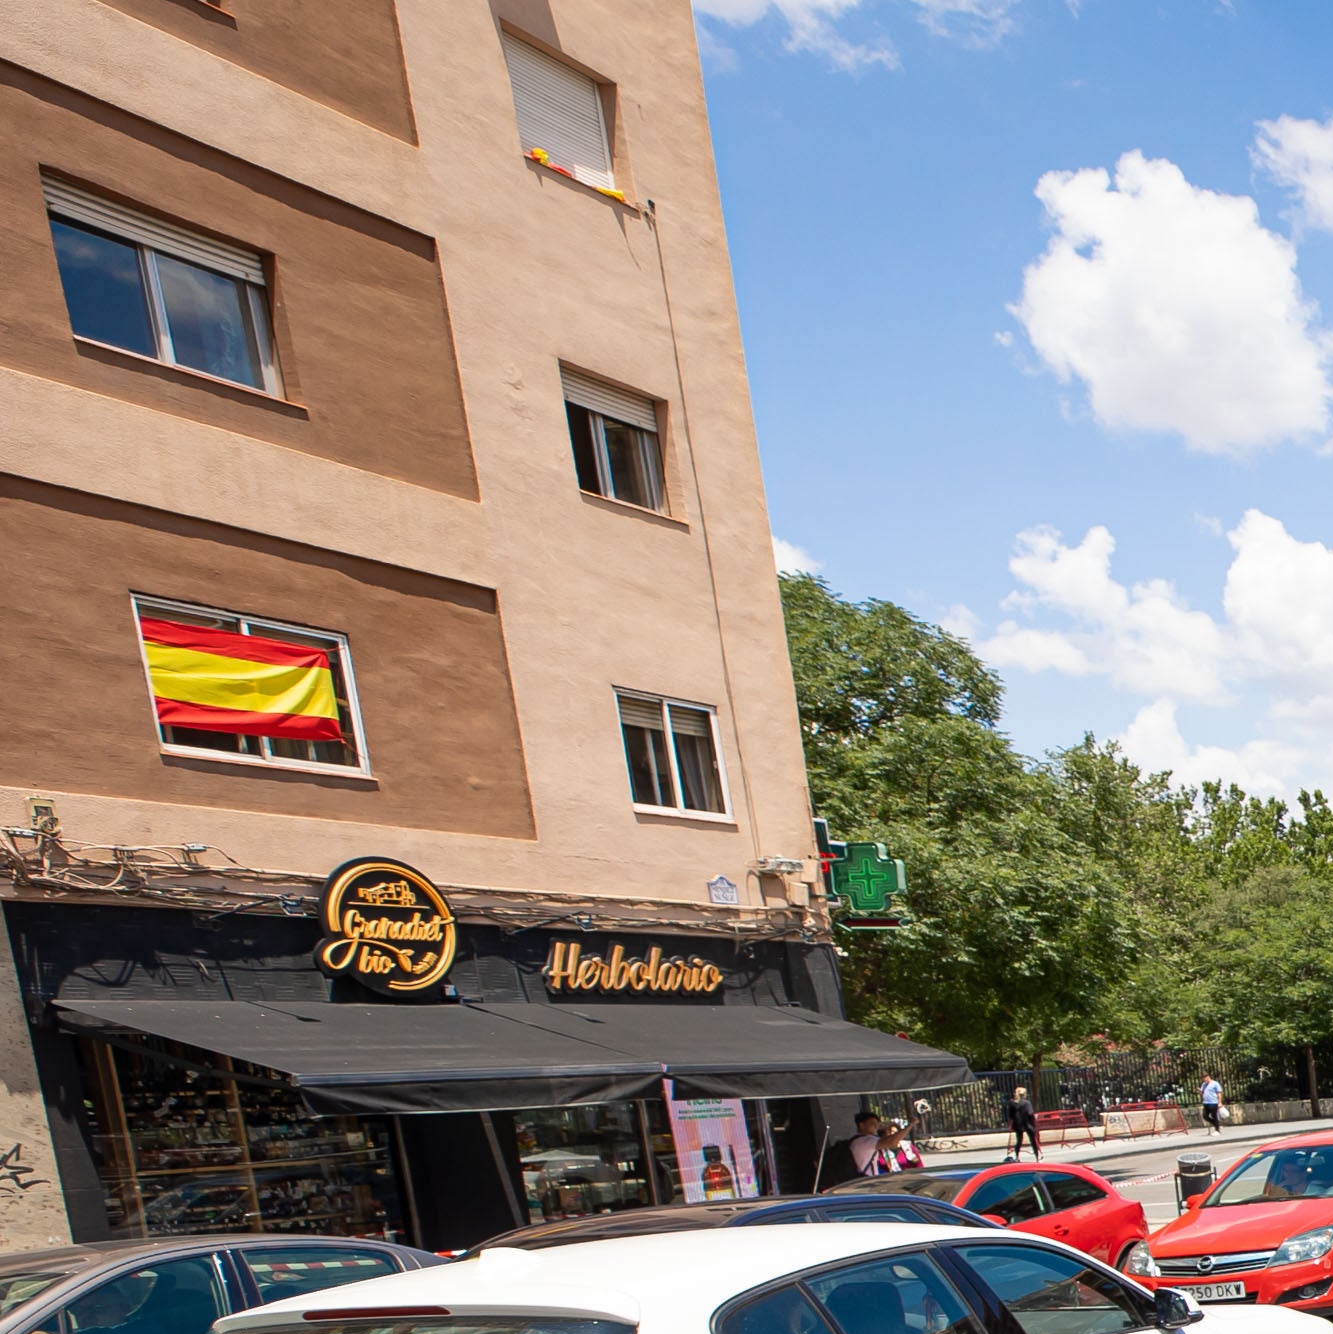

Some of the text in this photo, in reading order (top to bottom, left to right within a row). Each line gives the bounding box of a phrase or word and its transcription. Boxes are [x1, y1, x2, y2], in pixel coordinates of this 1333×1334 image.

[358, 945, 396, 974] bio
[549, 942, 723, 992] Herbolario
[1216, 1283, 1242, 1297] DKW
